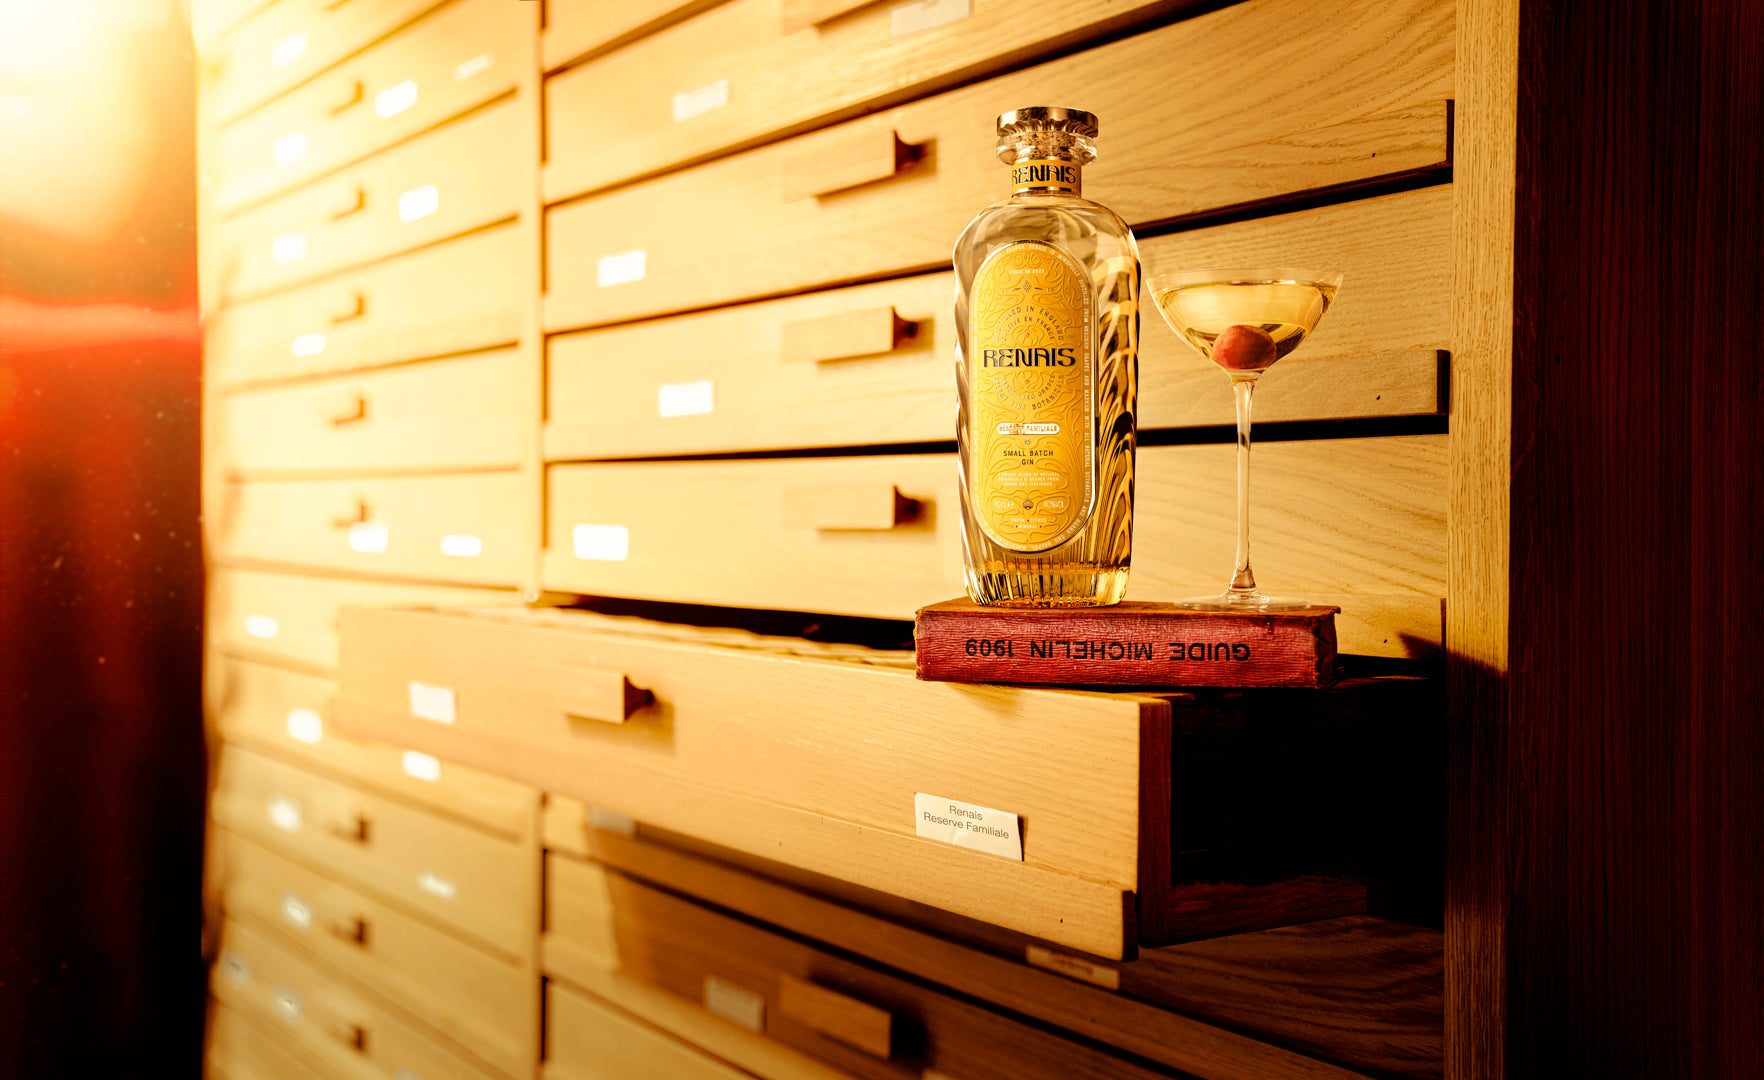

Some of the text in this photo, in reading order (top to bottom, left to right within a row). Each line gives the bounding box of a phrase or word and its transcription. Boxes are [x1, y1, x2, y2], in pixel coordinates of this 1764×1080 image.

[1012, 165, 1076, 184] RENAIS
[1035, 318, 1055, 340] FRANCE
[1039, 308, 1064, 341] ENGLAND
[983, 348, 1076, 368] RENAIS
[1031, 375, 1064, 410] BOTANICALS
[1037, 375, 1056, 397] GRAPES
[965, 638, 1251, 662] GUIDE MICHELIN 1909
[949, 805, 983, 821] Renais
[923, 811, 1009, 839] Reserve Familiale
